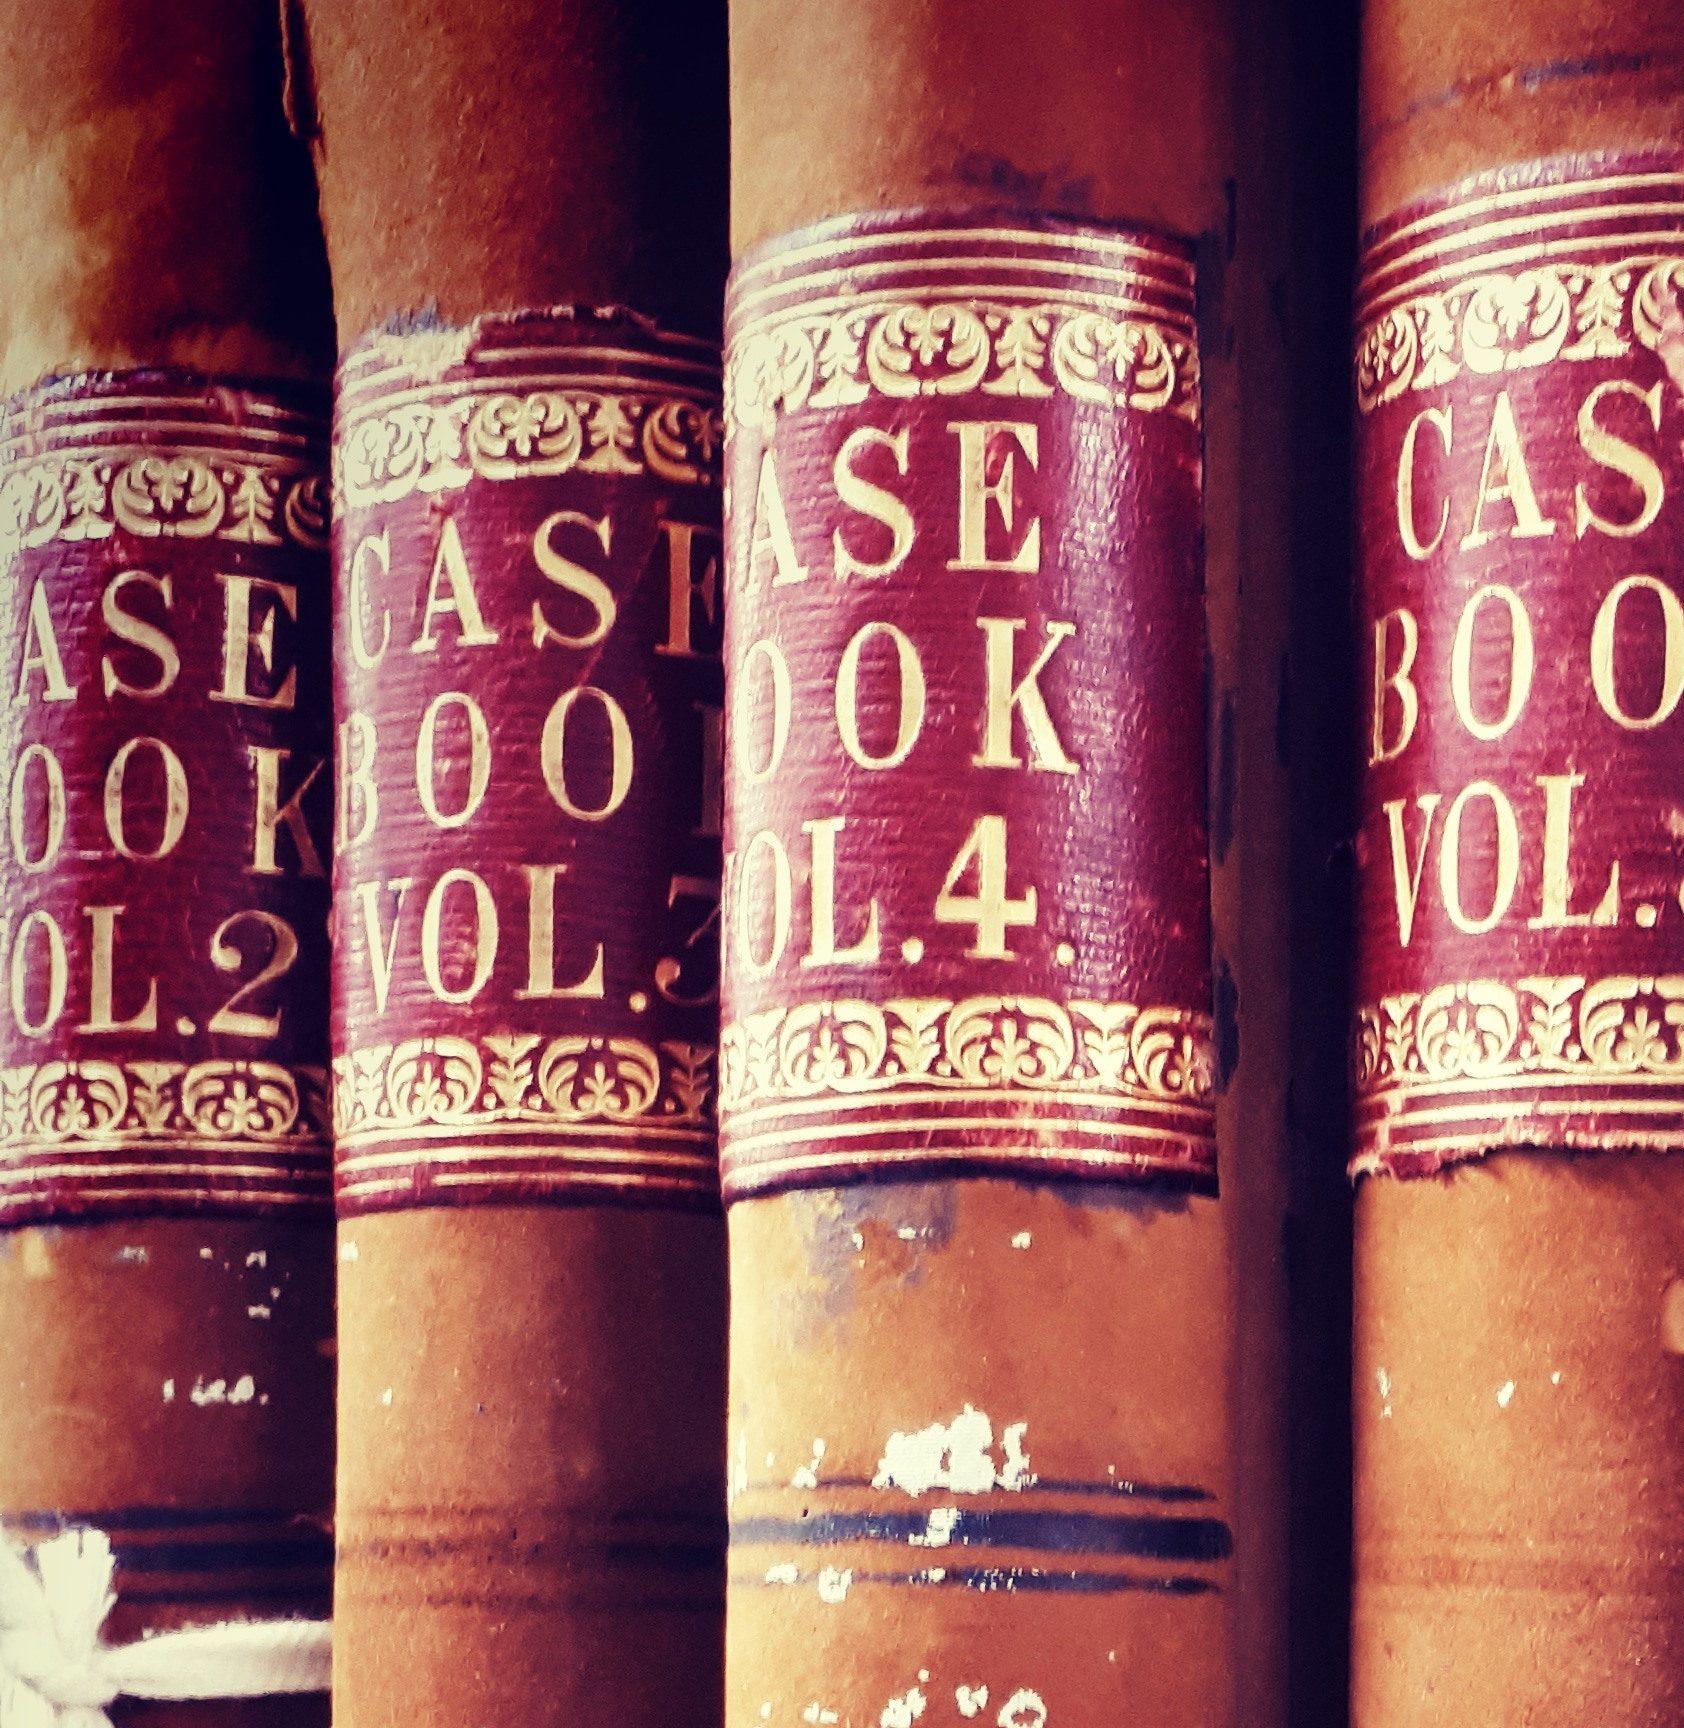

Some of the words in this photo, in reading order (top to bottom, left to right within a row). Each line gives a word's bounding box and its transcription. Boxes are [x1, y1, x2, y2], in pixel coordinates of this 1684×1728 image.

[9, 570, 299, 711] ASE
[348, 510, 722, 671] CASE
[9, 735, 327, 877] OOK
